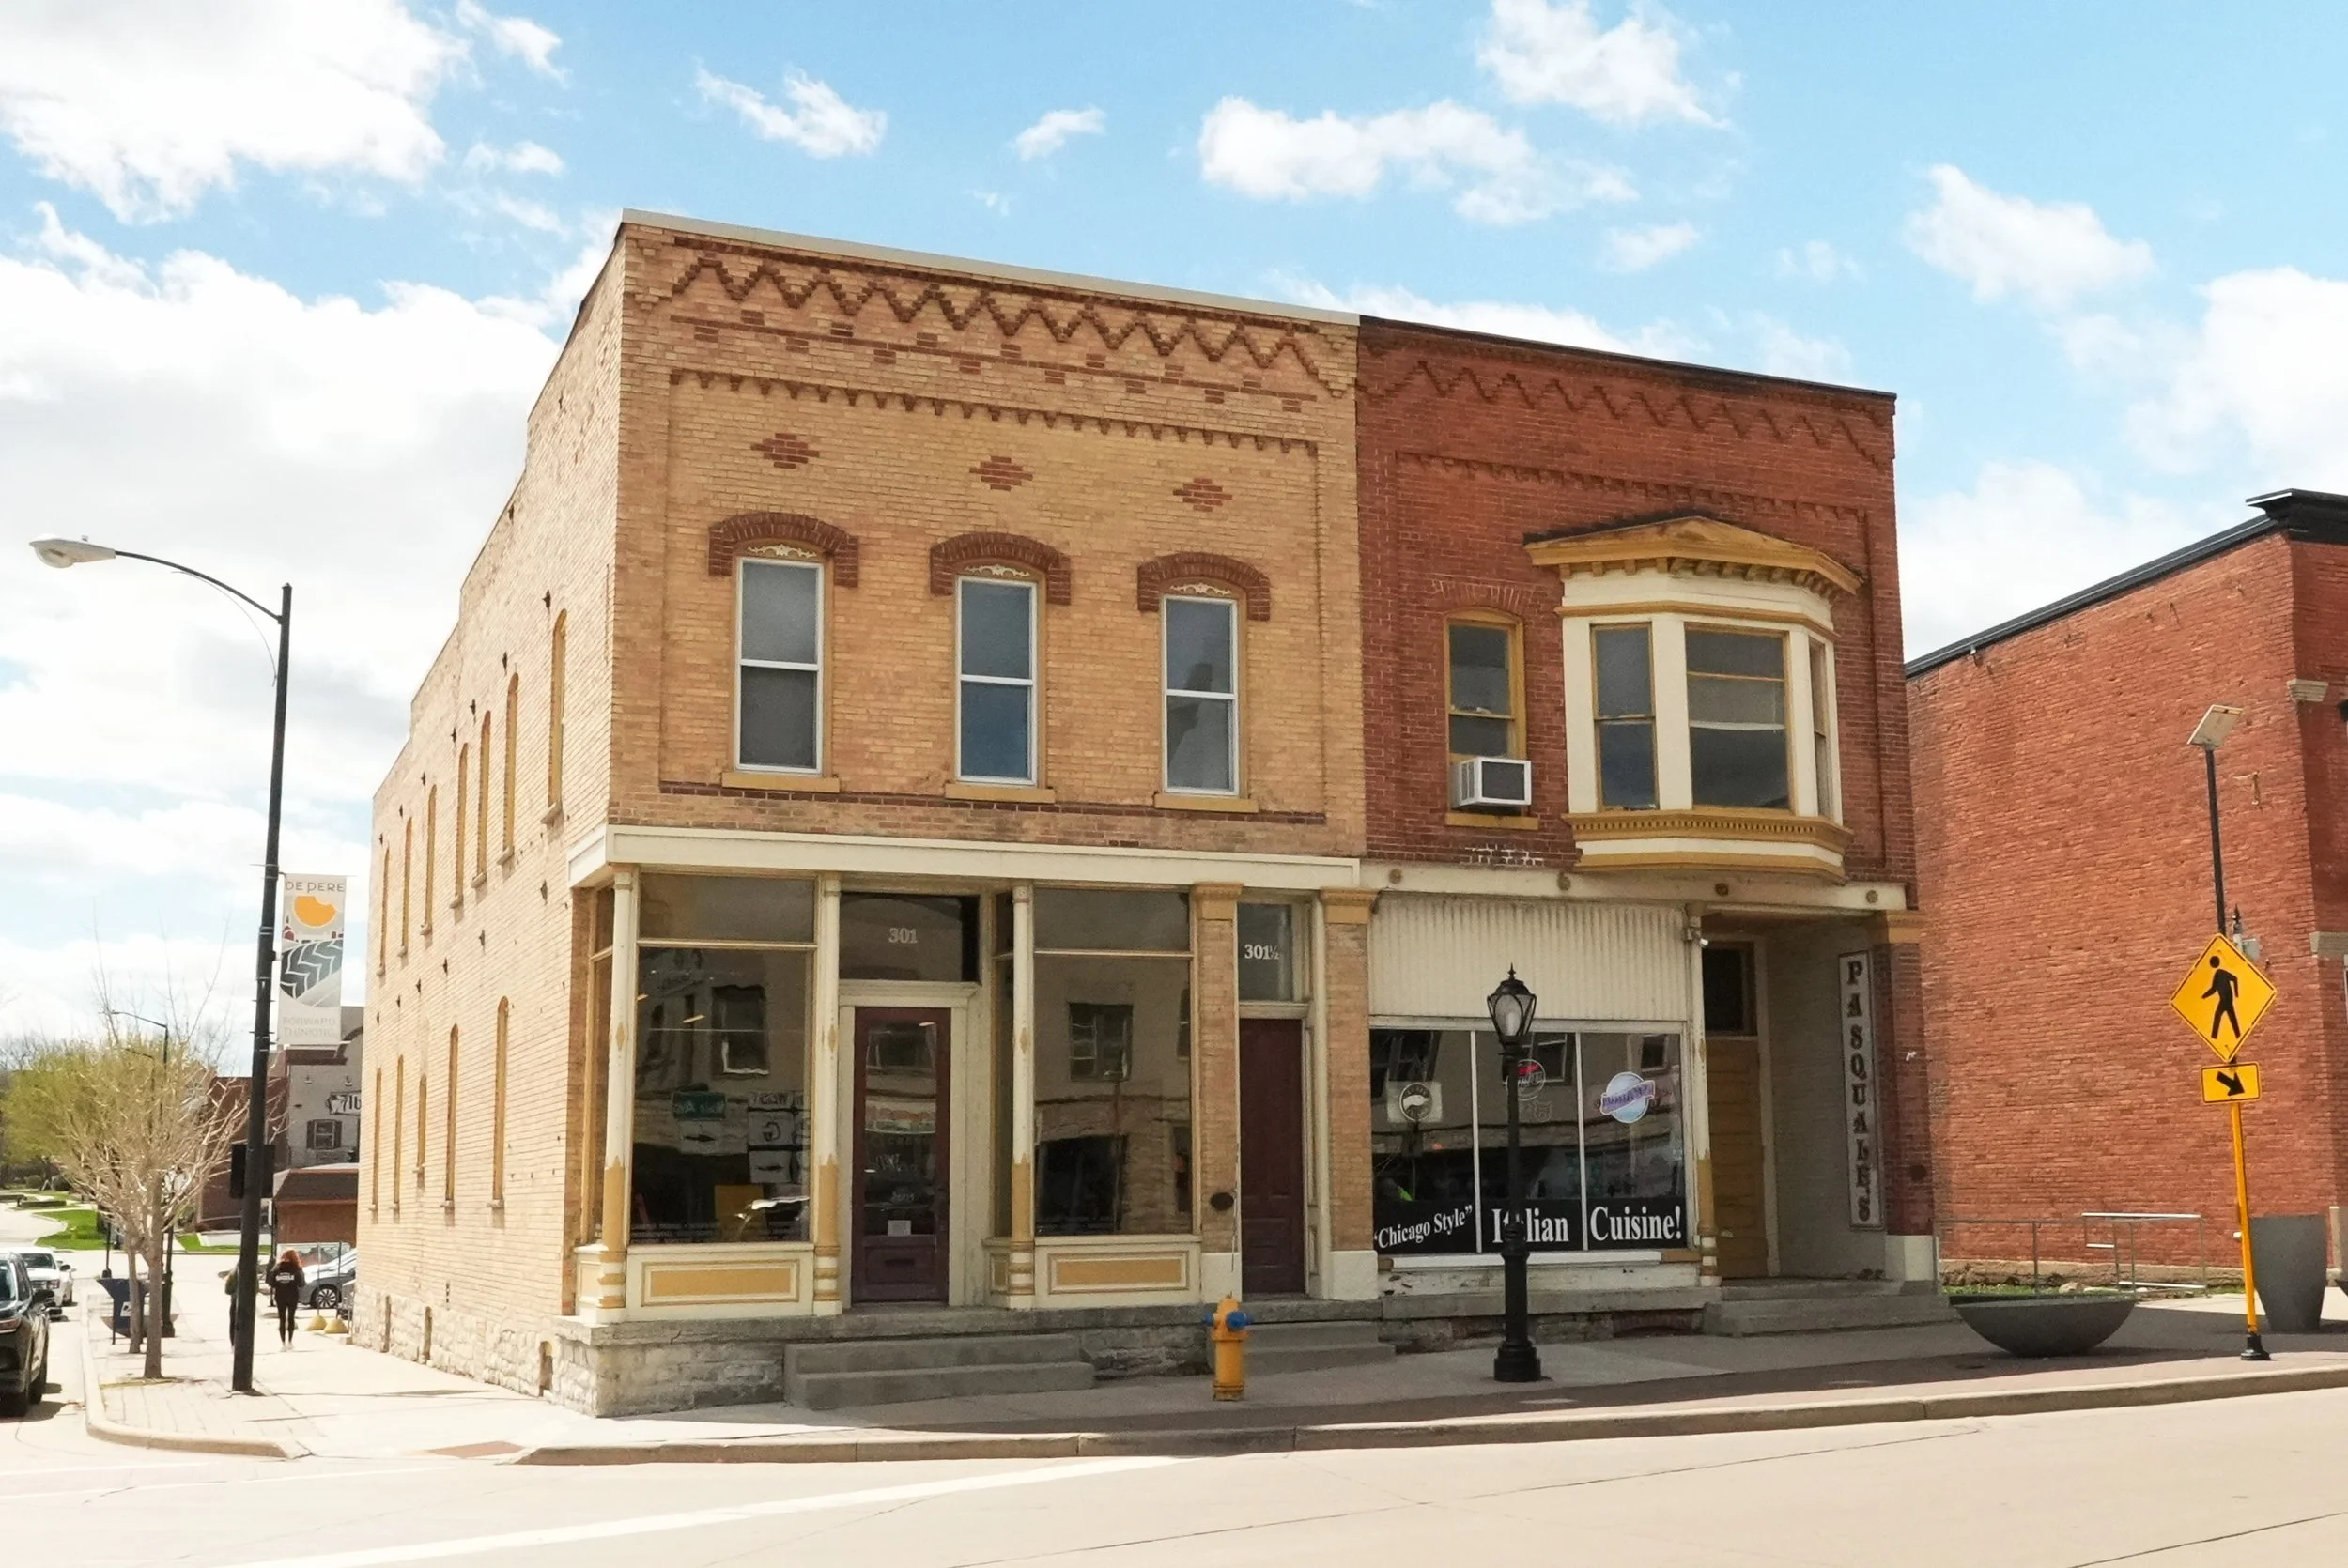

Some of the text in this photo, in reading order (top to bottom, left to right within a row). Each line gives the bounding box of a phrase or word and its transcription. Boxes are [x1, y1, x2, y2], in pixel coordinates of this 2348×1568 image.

[285, 881, 345, 894] DE PERE
[888, 928, 917, 944] 301
[1491, 1207, 1569, 1243] Ilian
[1590, 1206, 1682, 1241] Cuisine!
